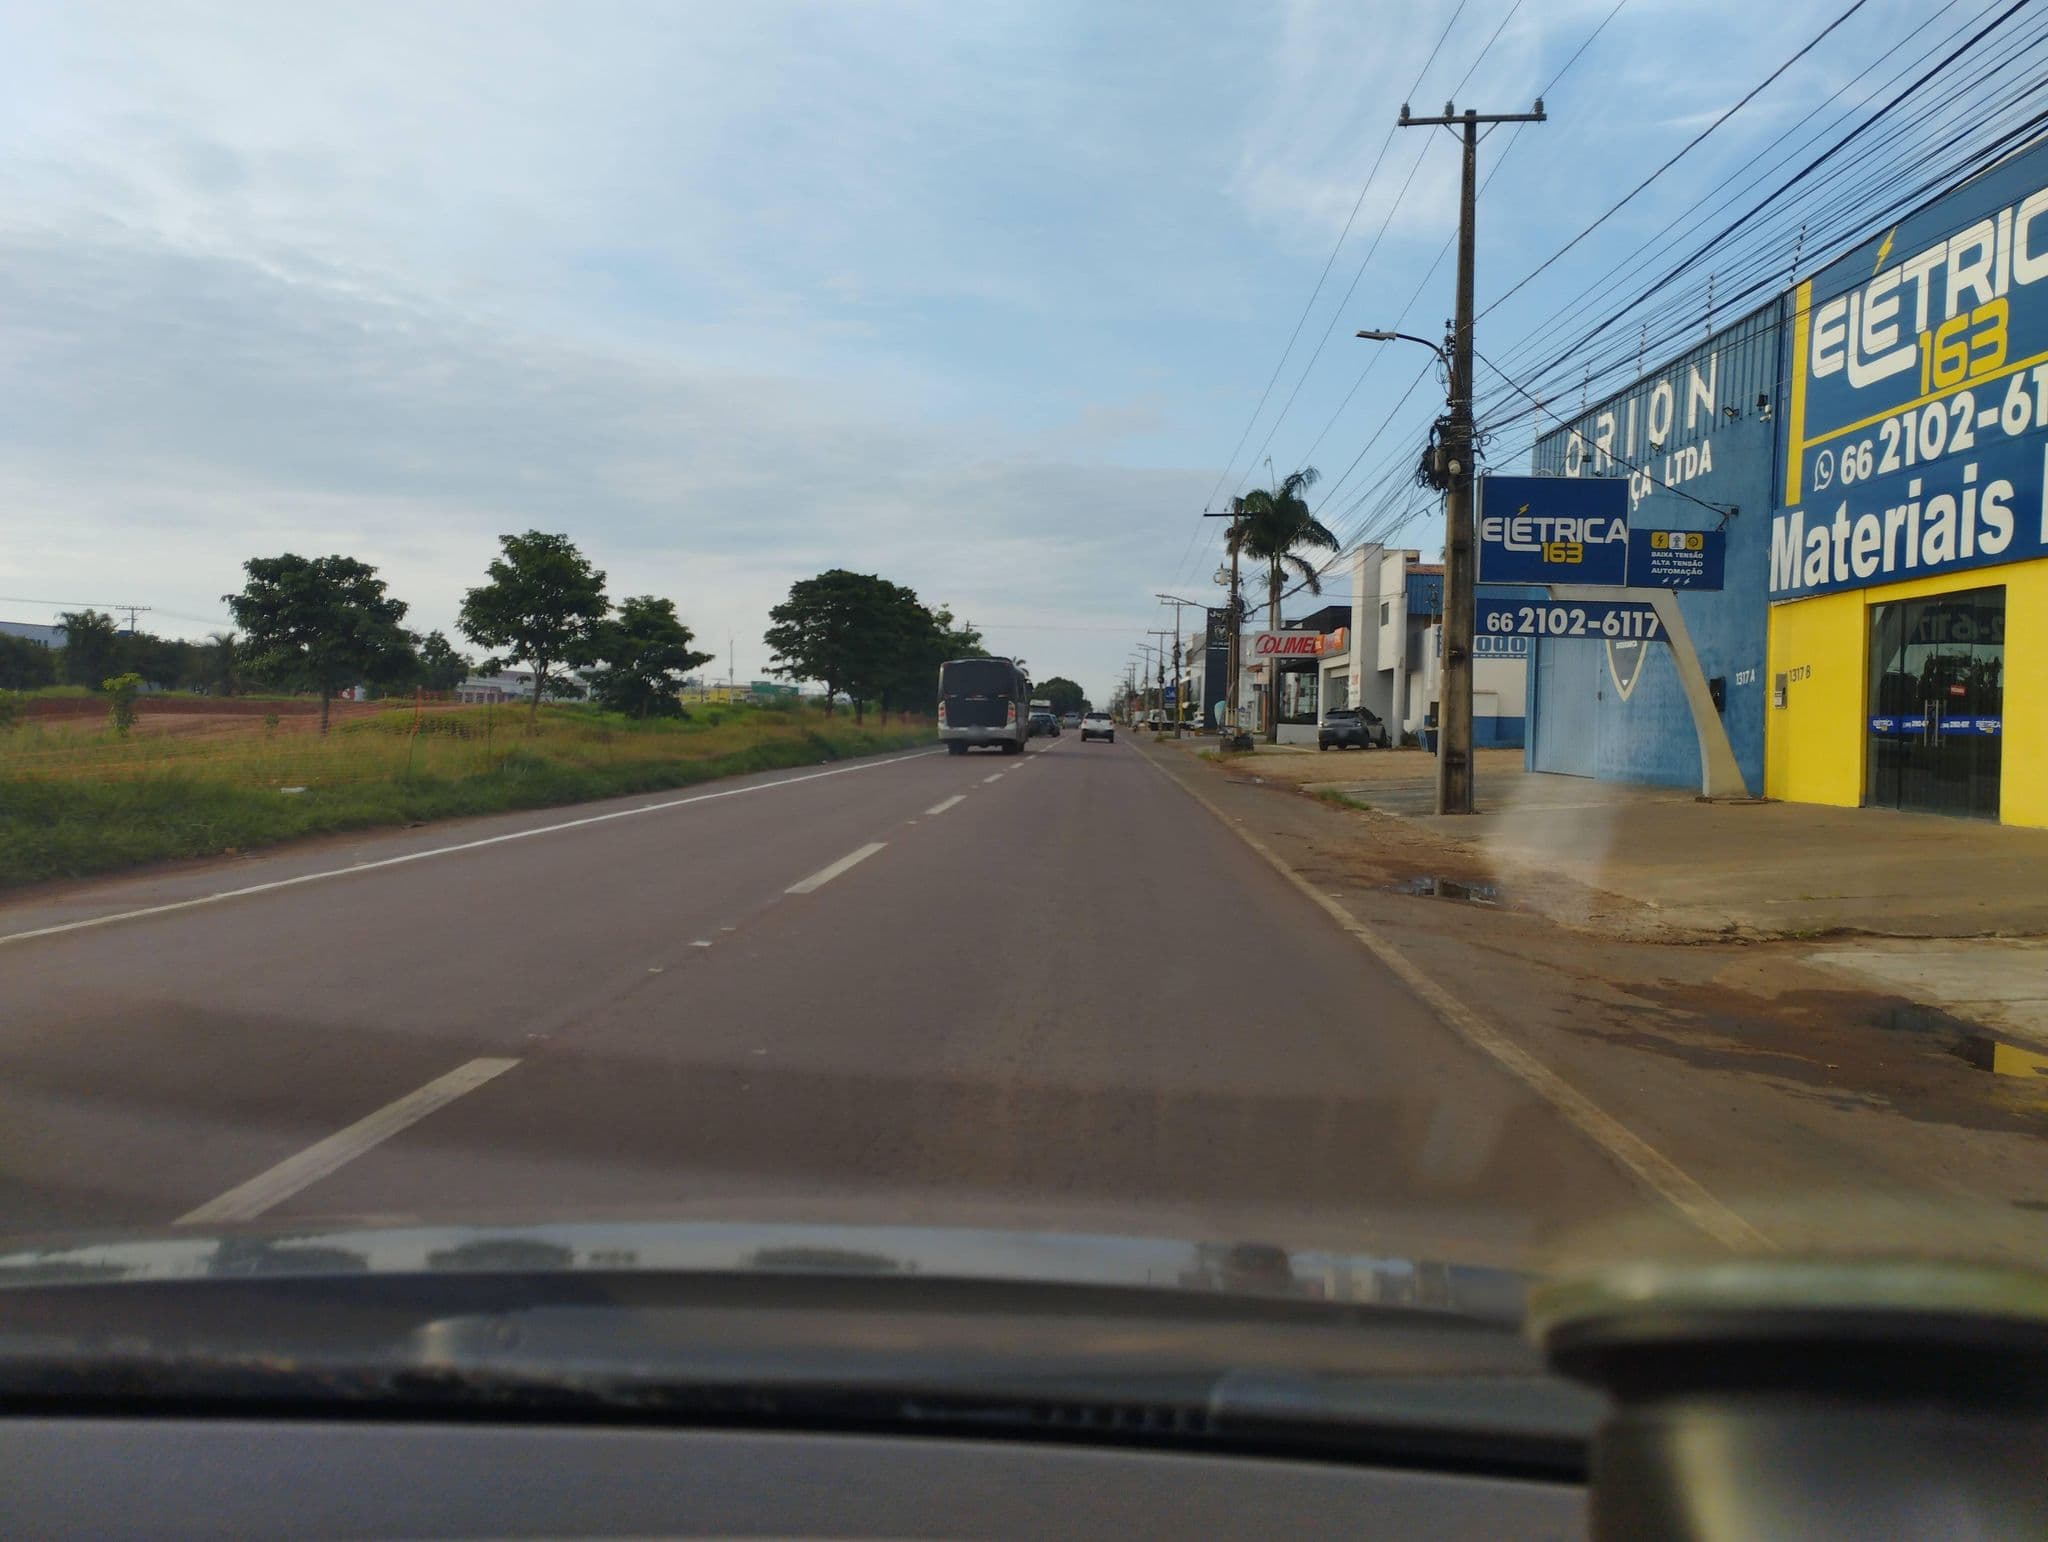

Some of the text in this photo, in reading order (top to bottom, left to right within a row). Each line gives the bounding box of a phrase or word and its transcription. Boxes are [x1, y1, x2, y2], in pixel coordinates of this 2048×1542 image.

[1919, 297, 2009, 396] 163
[1565, 352, 1718, 477] ORION
[1665, 440, 1712, 487] LTDA
[1840, 439, 1873, 485] 66
[1481, 504, 1629, 552] ELÉTRICA
[1769, 462, 2015, 592] Materiais
[1541, 542, 1583, 563] 163
[1651, 568, 1703, 576] AUTOMAÇÃO
[1675, 551, 1704, 559] TENSÃO
[1486, 607, 1661, 638] 66 2102-6117
